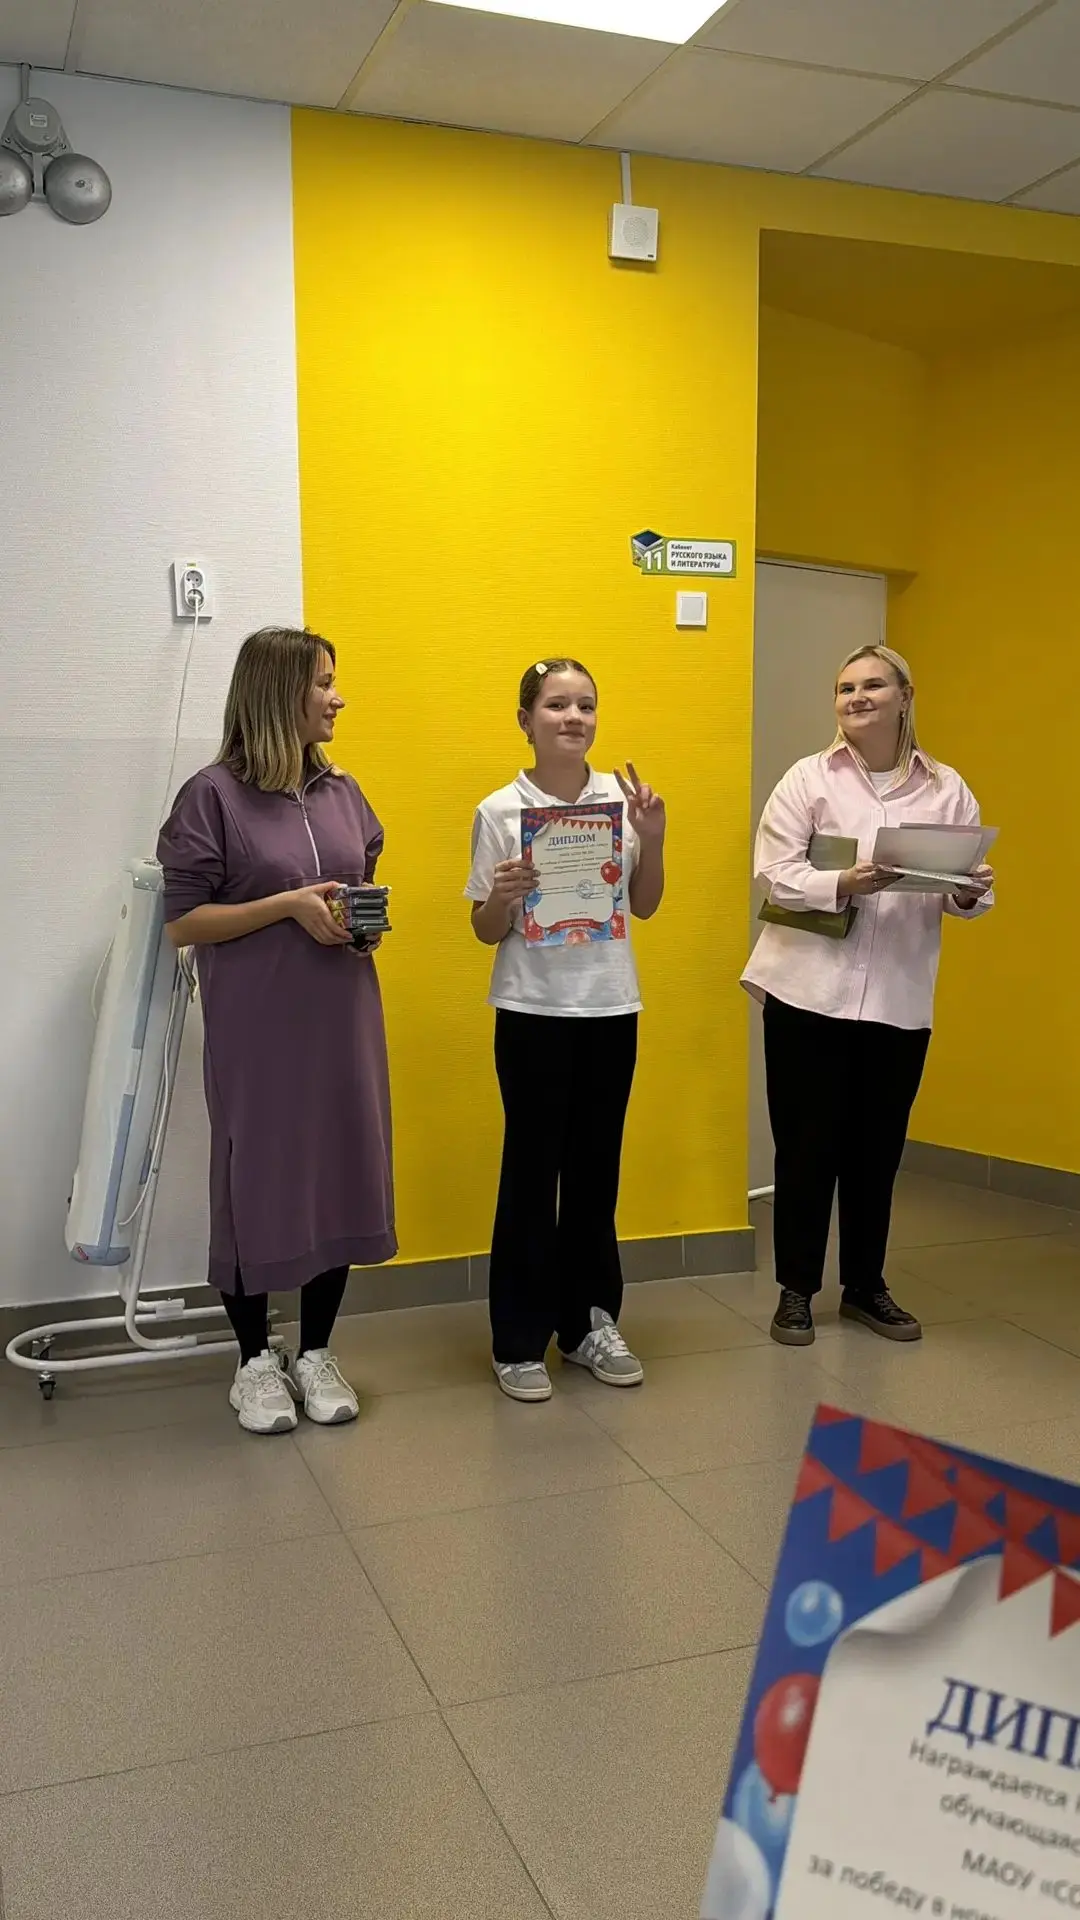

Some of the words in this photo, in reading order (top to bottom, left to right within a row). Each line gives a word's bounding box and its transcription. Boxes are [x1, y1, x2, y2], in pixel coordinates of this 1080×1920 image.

[644, 551, 662, 570] 11
[671, 551, 702, 560] РУССКОГО
[703, 552, 727, 561] ЯЗЫКА
[677, 560, 721, 569] ЛИТЕРАТУРЫ
[548, 833, 596, 847] ДИПЛОМ
[925, 1676, 1080, 1771] ДИП
[909, 1736, 1068, 1812] Награждается
[961, 1849, 1036, 1891] МАОУ
[807, 1854, 835, 1878] за
[839, 1865, 928, 1912] победу
[931, 1896, 946, 1917] в
